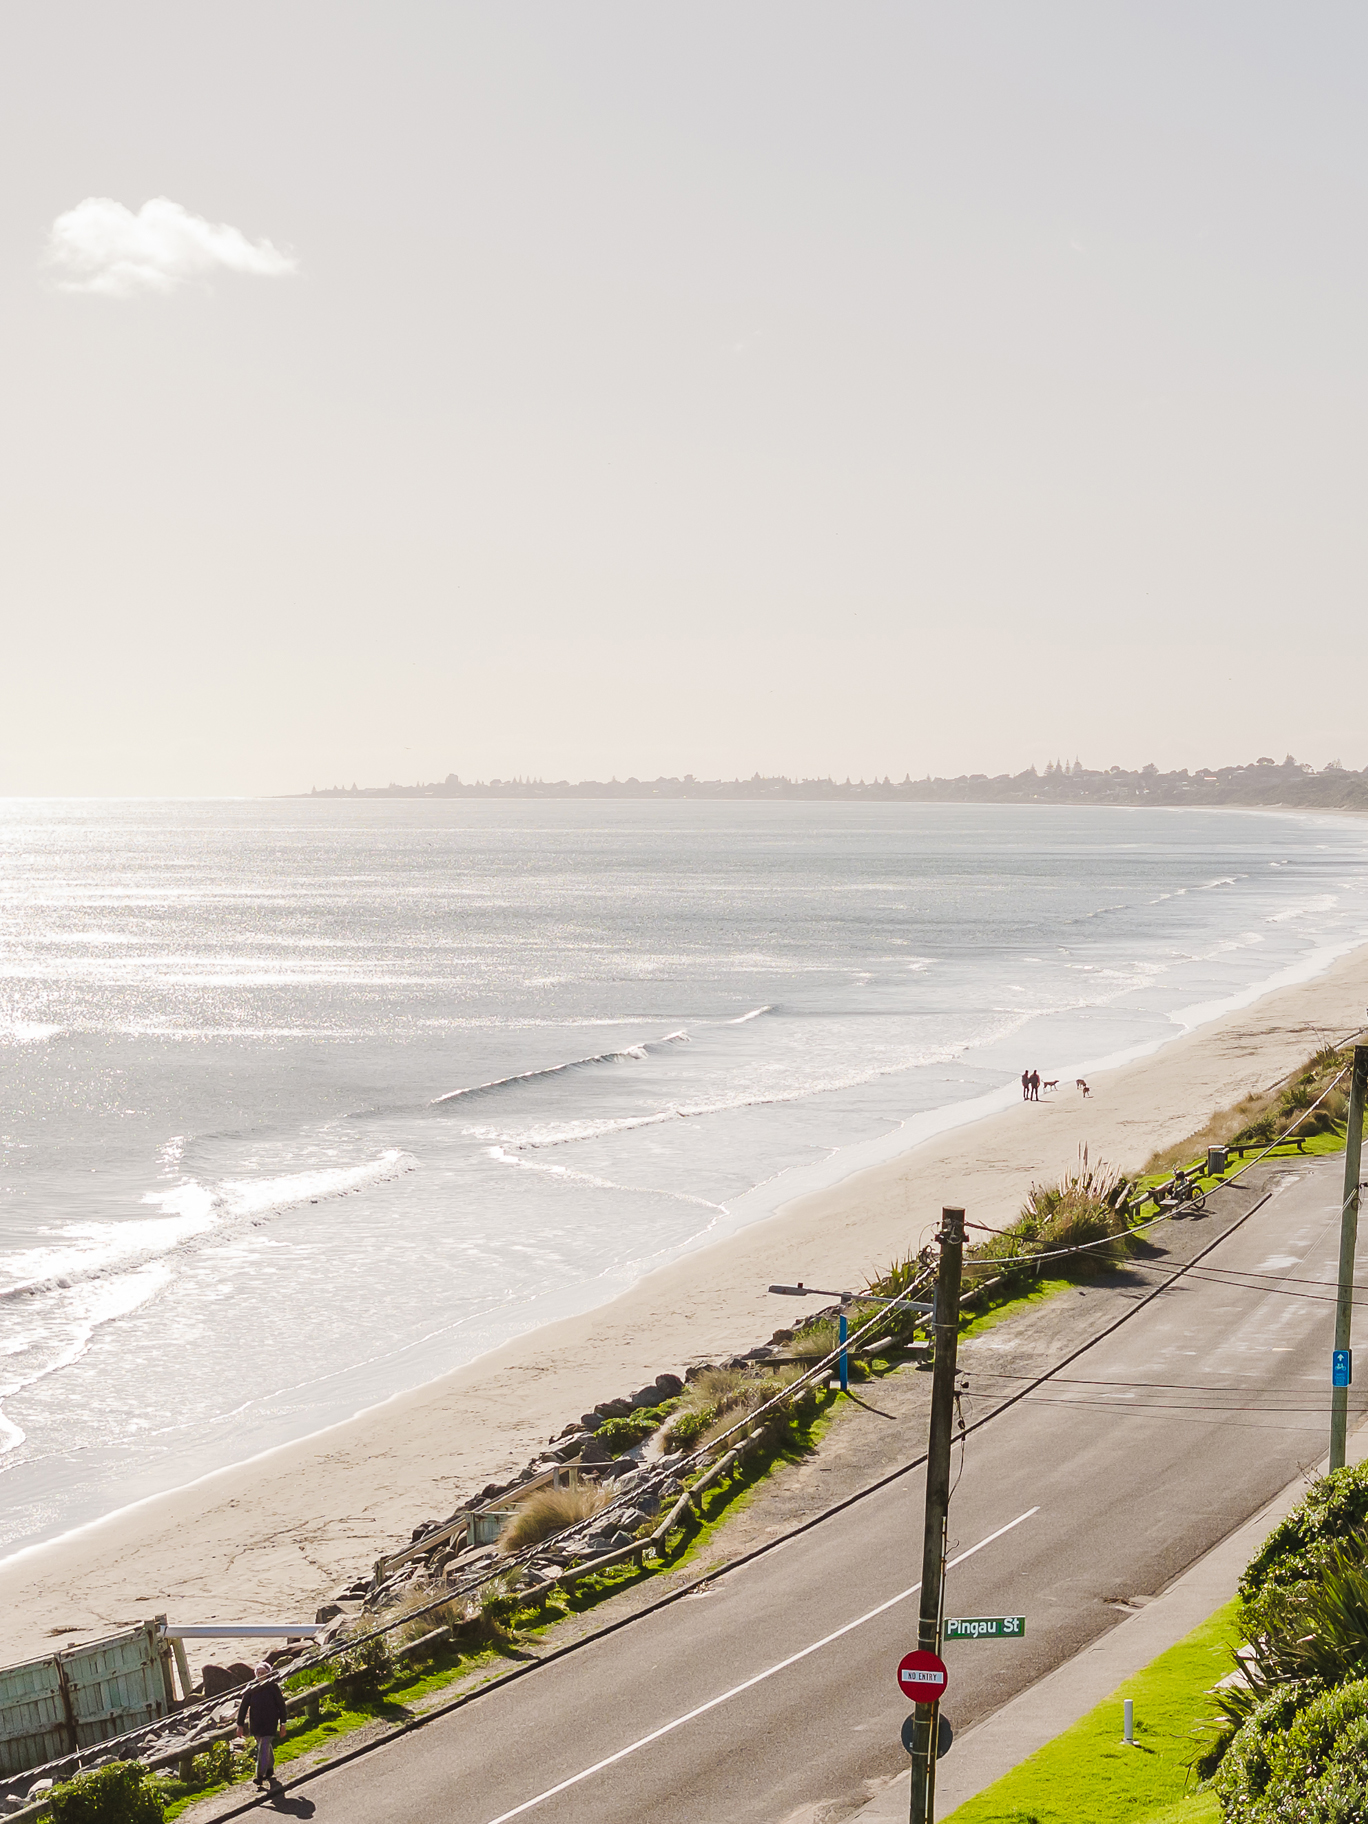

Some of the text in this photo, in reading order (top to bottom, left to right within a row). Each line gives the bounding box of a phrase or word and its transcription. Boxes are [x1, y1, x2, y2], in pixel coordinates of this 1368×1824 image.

[947, 1617, 1020, 1638] Pingau St
[907, 1672, 938, 1681] NO ENTRY
